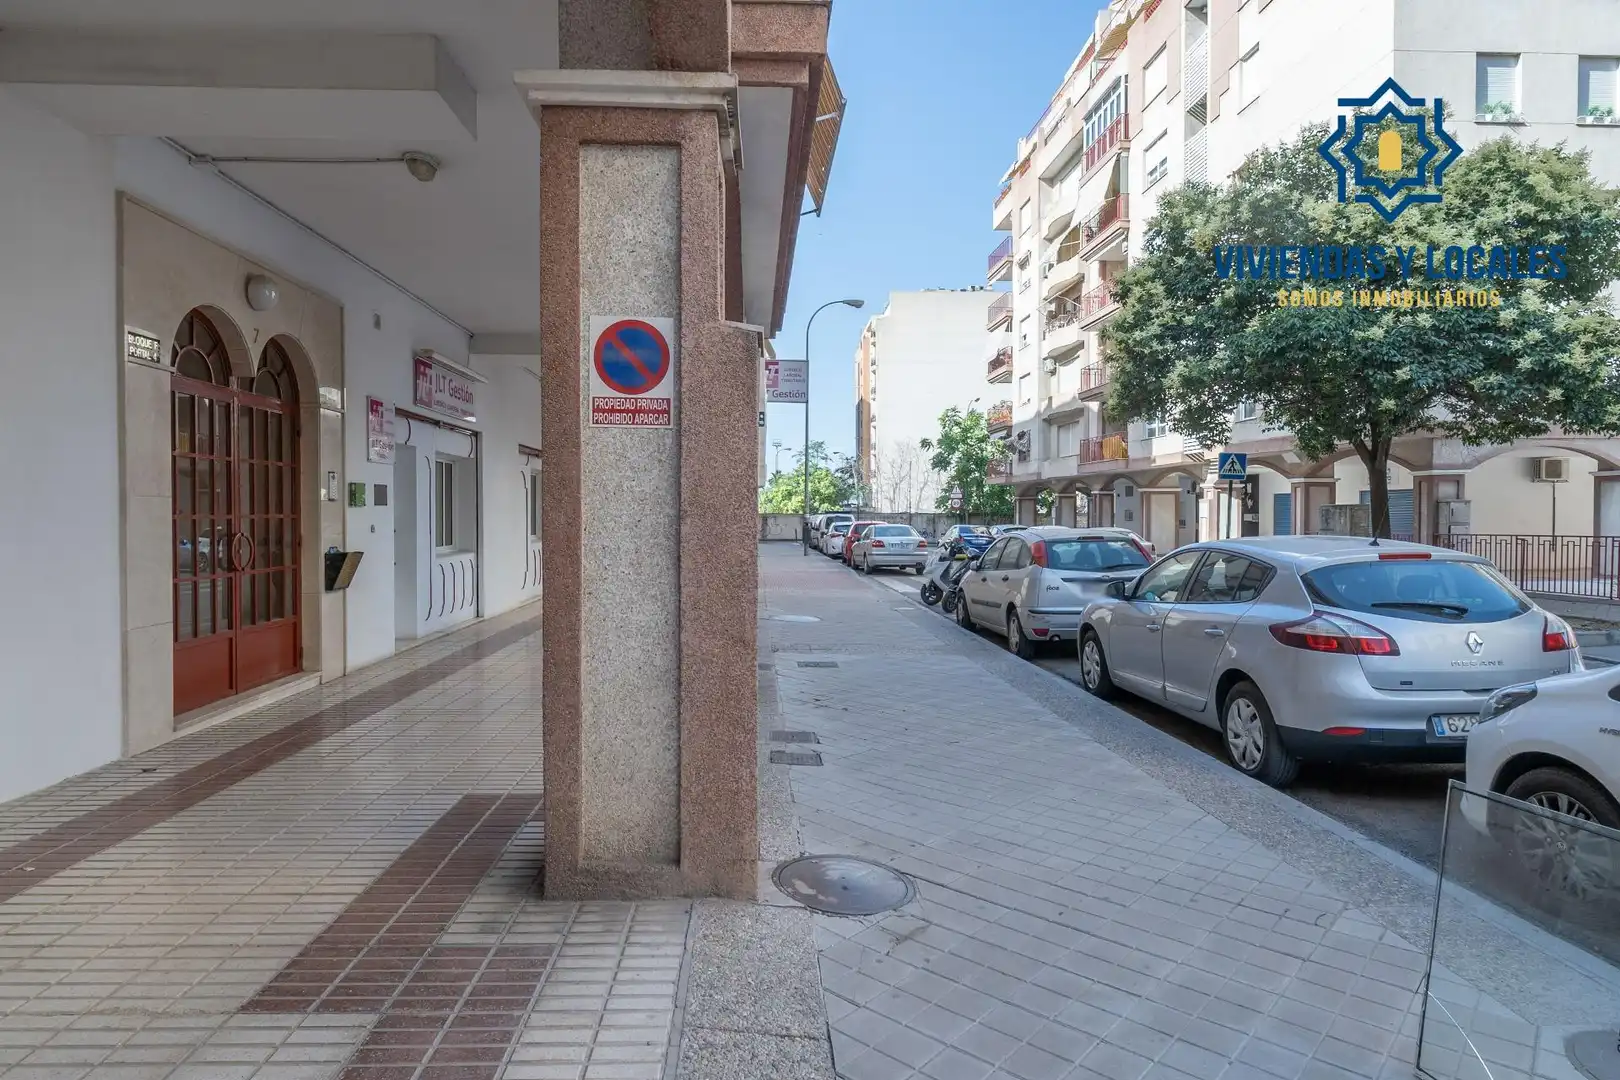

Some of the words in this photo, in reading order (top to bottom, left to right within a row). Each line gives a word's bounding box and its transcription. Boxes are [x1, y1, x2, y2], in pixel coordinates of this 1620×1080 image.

[128, 334, 153, 349] BLOQUE
[129, 346, 152, 360] PORTAL
[434, 372, 446, 394] JLT
[448, 379, 474, 405] Gestión
[772, 389, 806, 399] Gestión
[594, 398, 635, 410] PROPIEDAD
[637, 399, 669, 410] PRIVADA
[593, 413, 633, 424] PROHIBIDO
[634, 413, 669, 425] APARCAR
